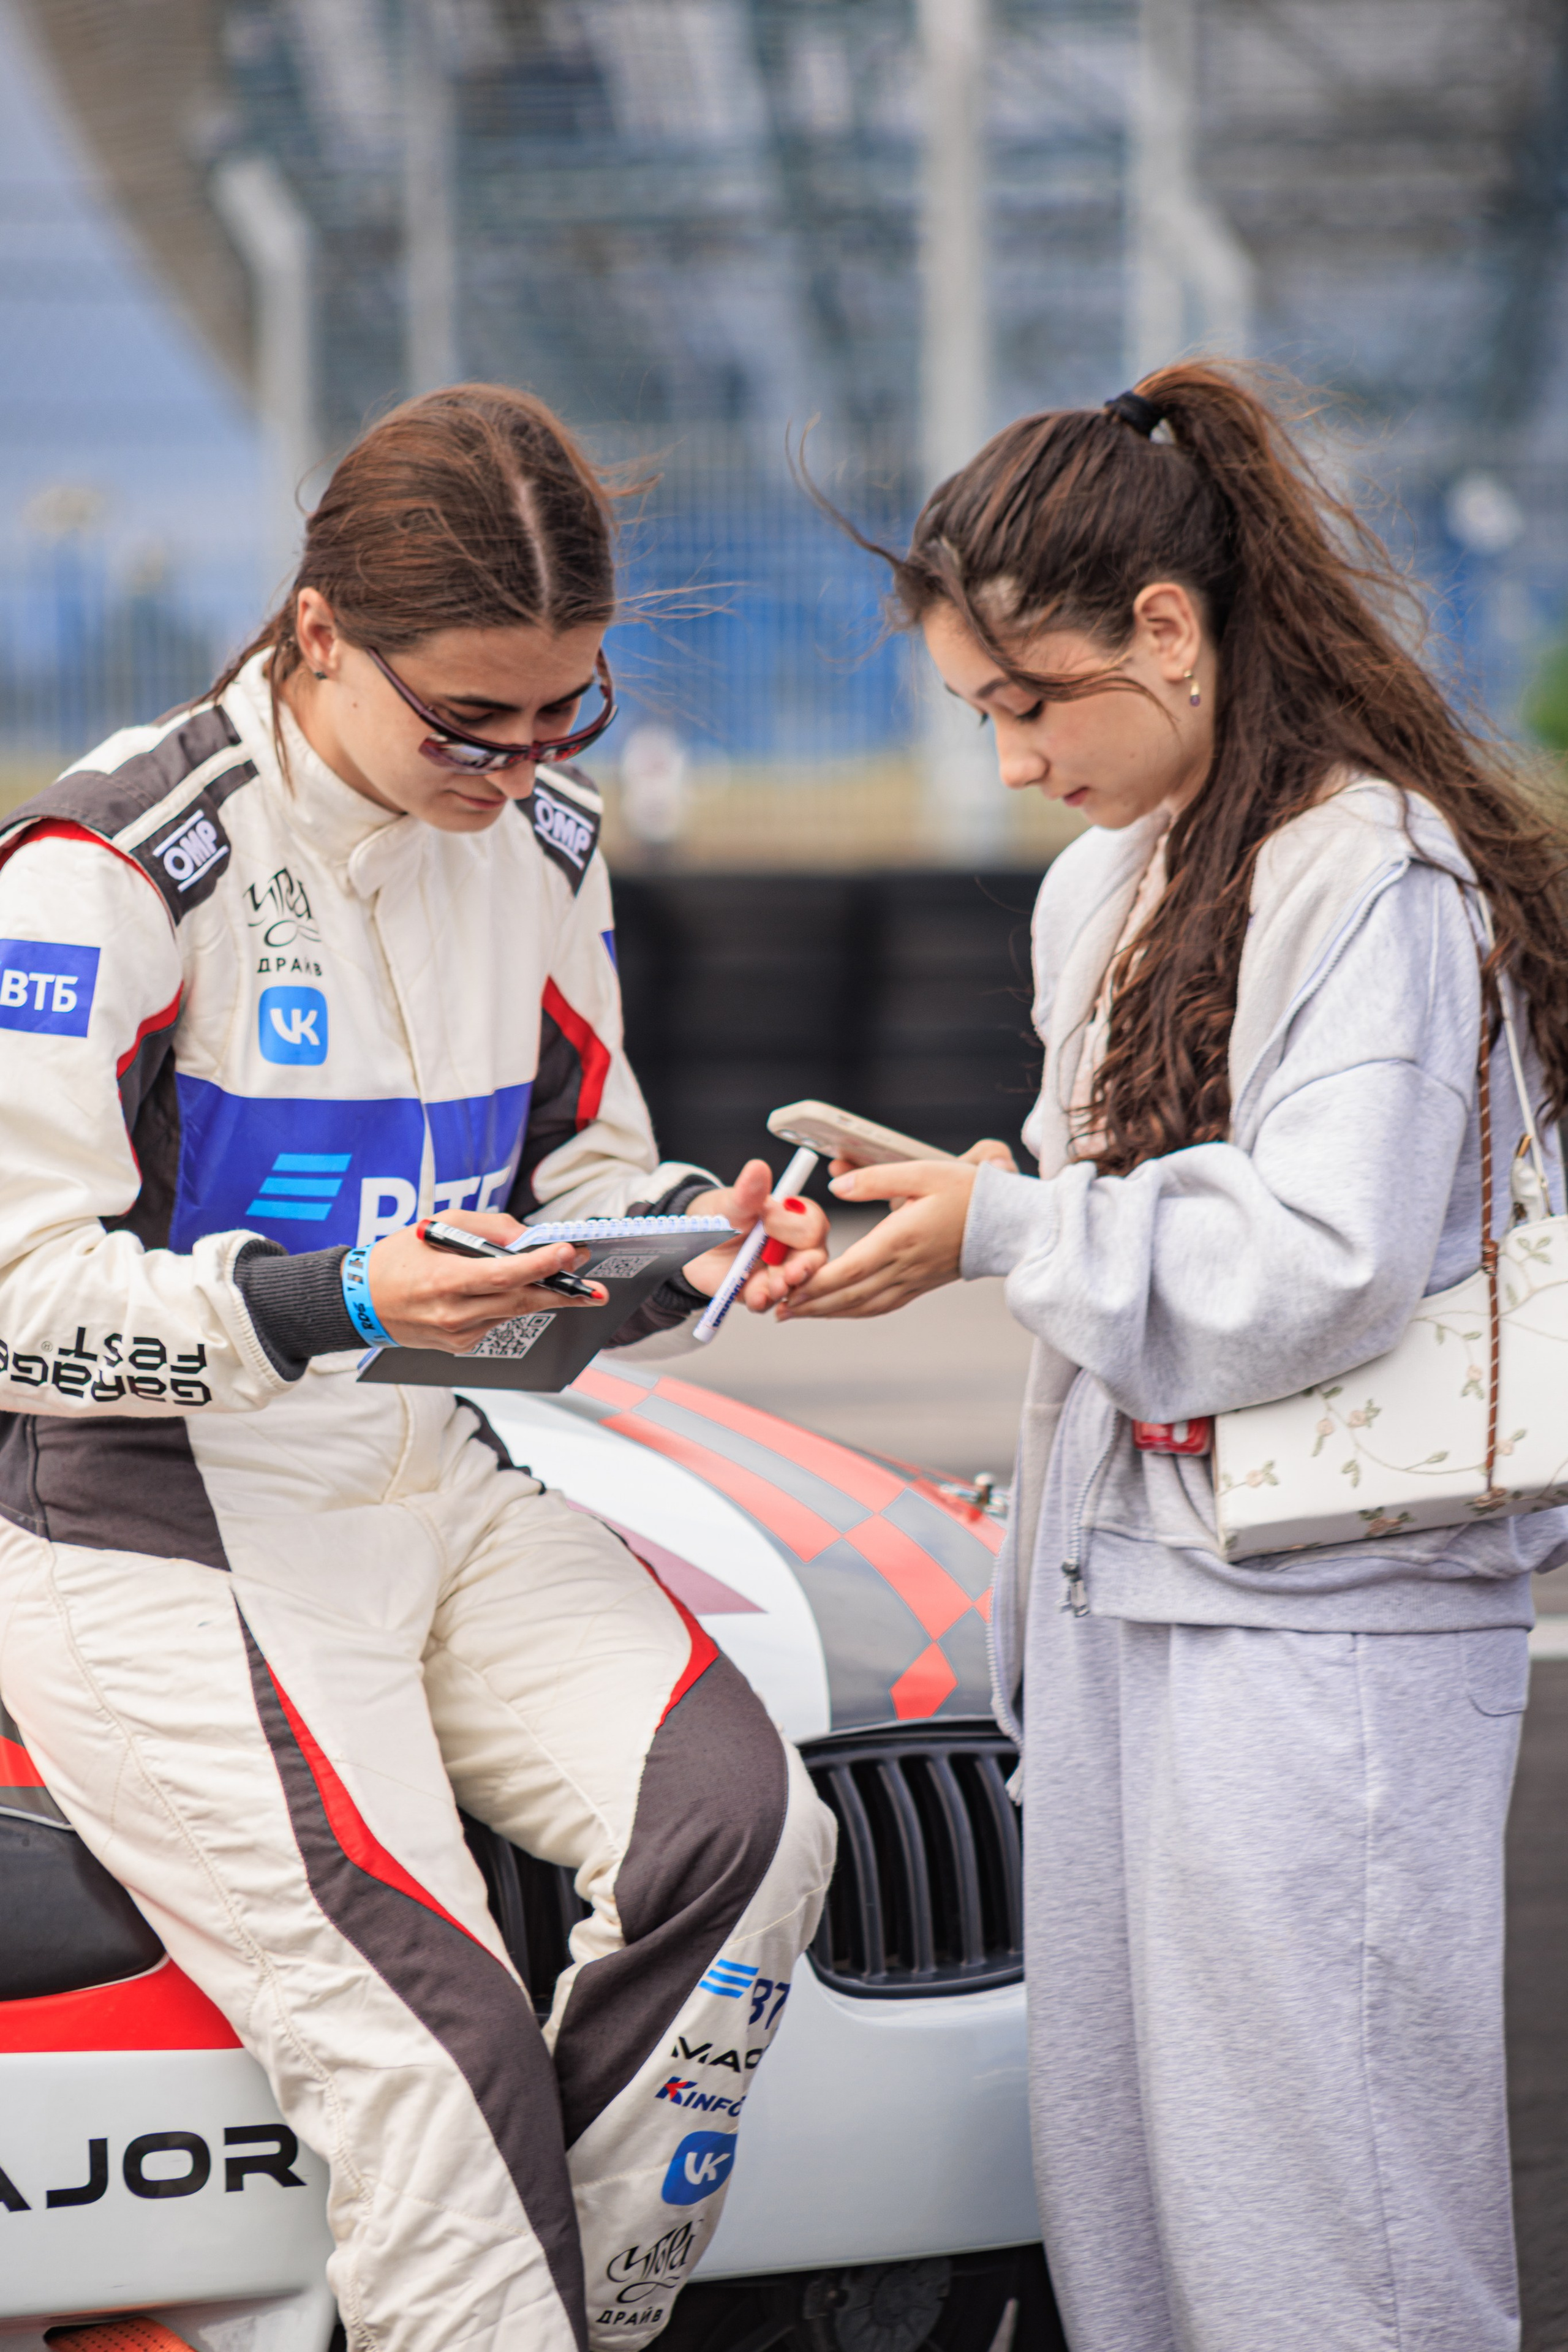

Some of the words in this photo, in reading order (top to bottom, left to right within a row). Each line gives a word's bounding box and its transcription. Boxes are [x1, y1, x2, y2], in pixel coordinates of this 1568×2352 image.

[533, 799, 592, 855] OMP
[163, 819, 218, 880] OMP
[0, 968, 79, 1013] ВТБ
[270, 1008, 320, 1046] VK
[655, 2076, 747, 2117] KINFO
[684, 2152, 731, 2185] VK
[595, 2306, 664, 2326] ДРАЙВ
